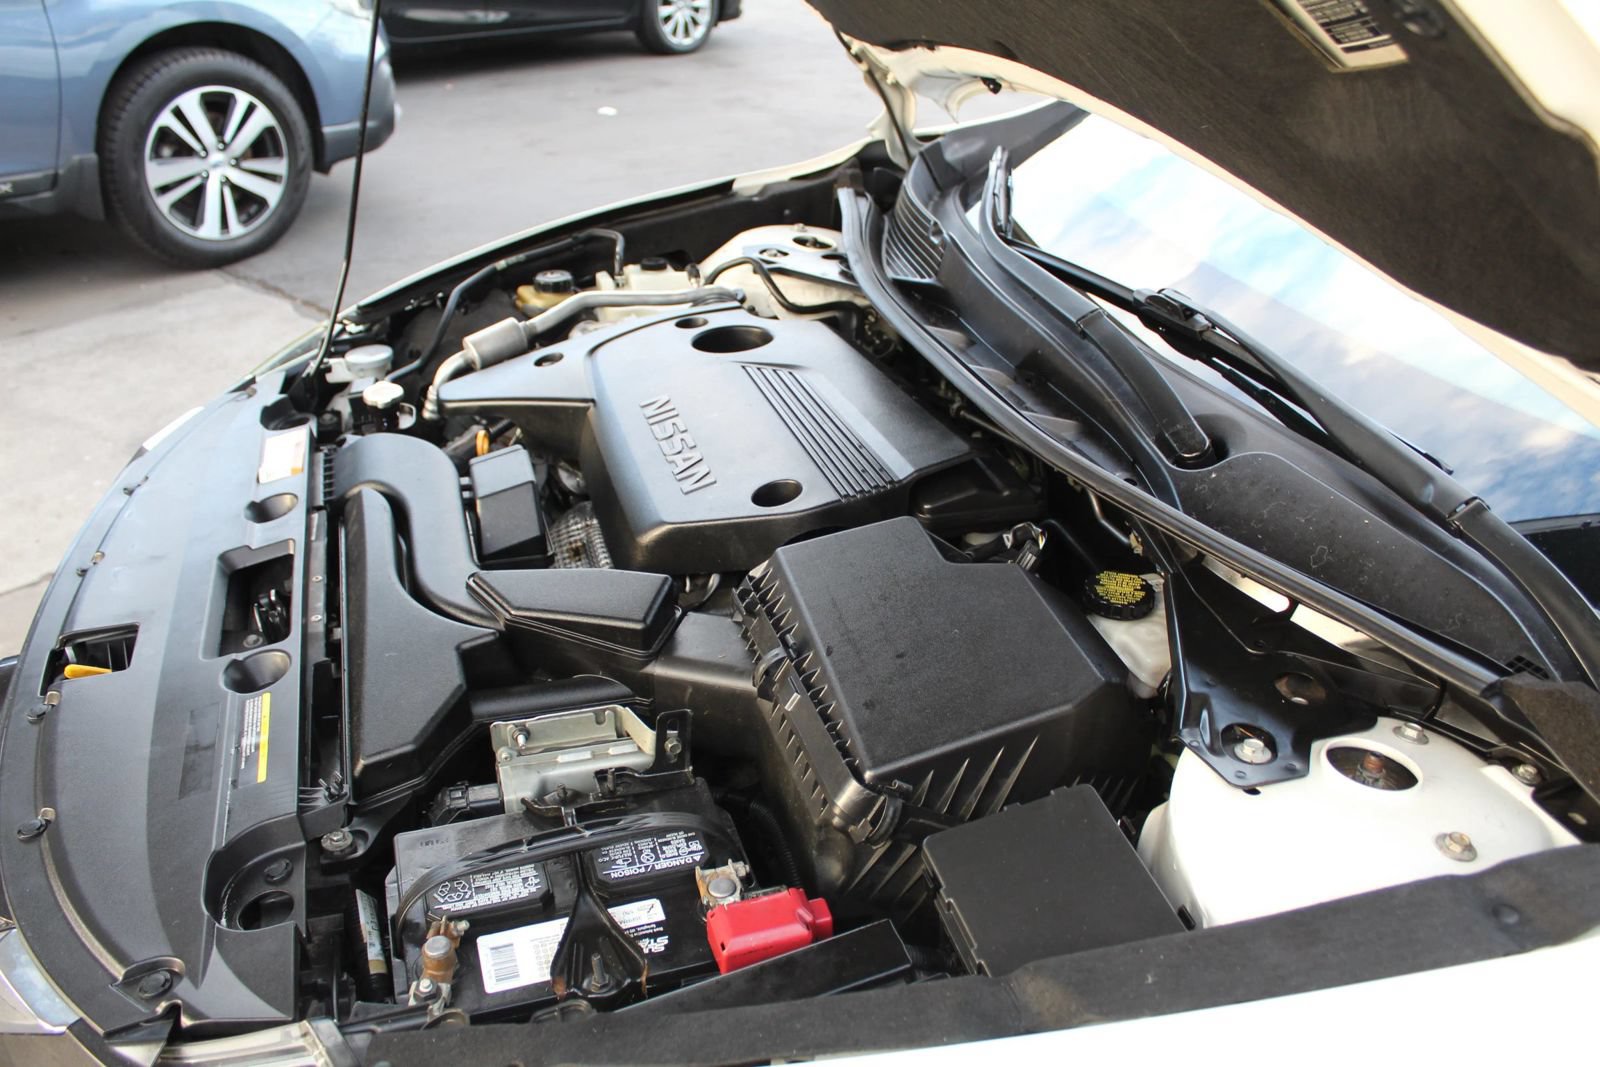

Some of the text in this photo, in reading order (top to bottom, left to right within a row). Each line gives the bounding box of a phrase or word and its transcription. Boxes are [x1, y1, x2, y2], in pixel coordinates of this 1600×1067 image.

[639, 394, 717, 495] NISSAN
[655, 856, 694, 870] DANGER
[610, 867, 646, 878] POISON
[636, 935, 669, 948] STA
[643, 943, 665, 954] SU
